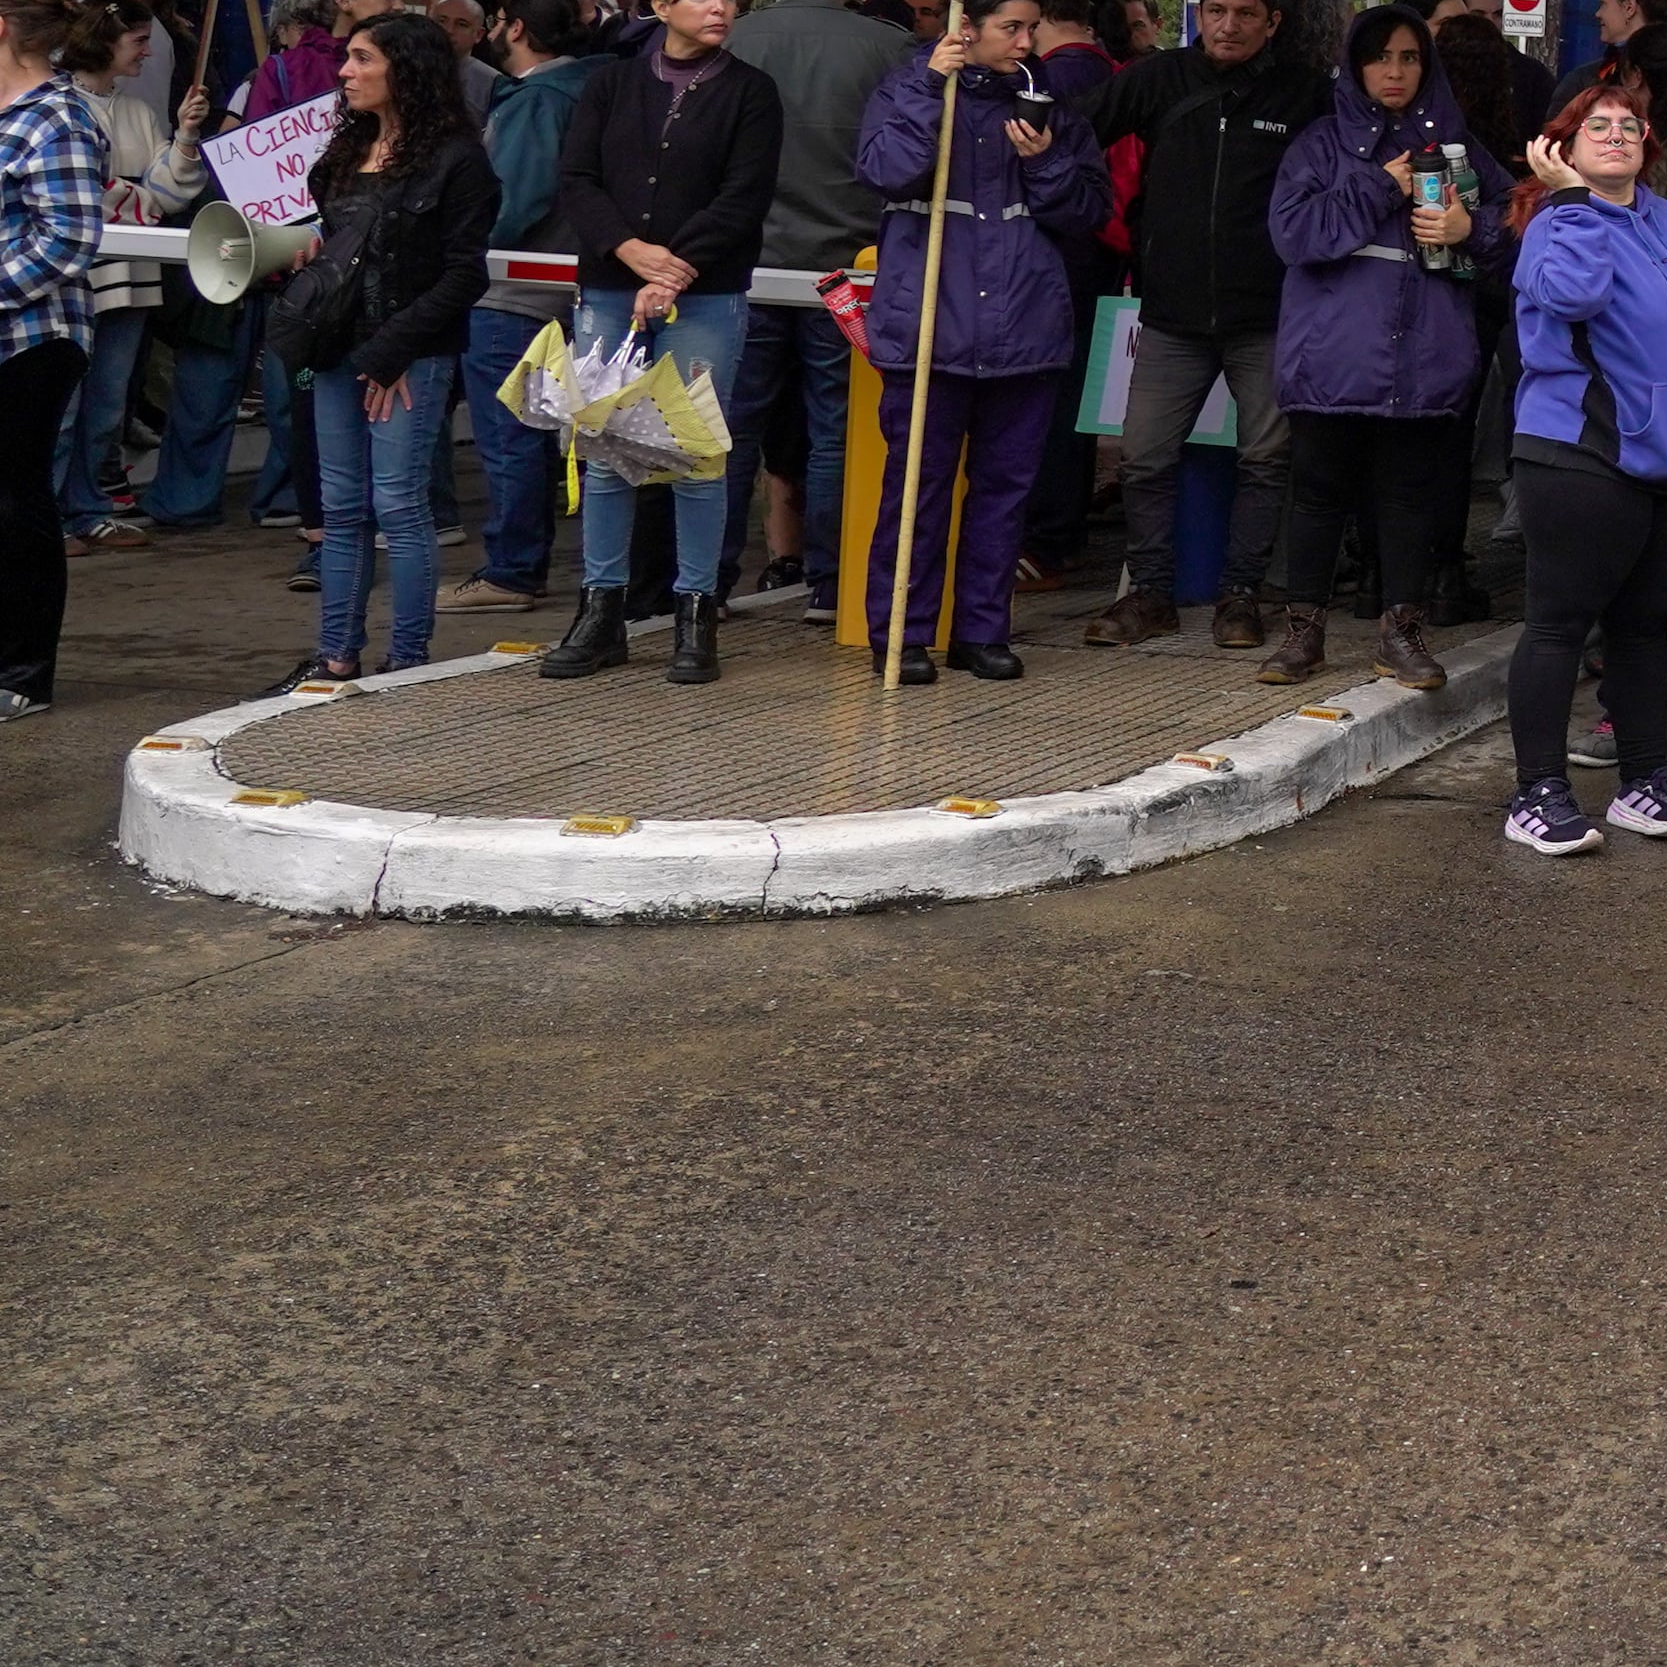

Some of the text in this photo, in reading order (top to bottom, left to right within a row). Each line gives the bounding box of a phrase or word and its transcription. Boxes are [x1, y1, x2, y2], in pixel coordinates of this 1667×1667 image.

[1265, 121, 1287, 133] INTI
[216, 142, 245, 166] LA
[275, 153, 305, 183] NO
